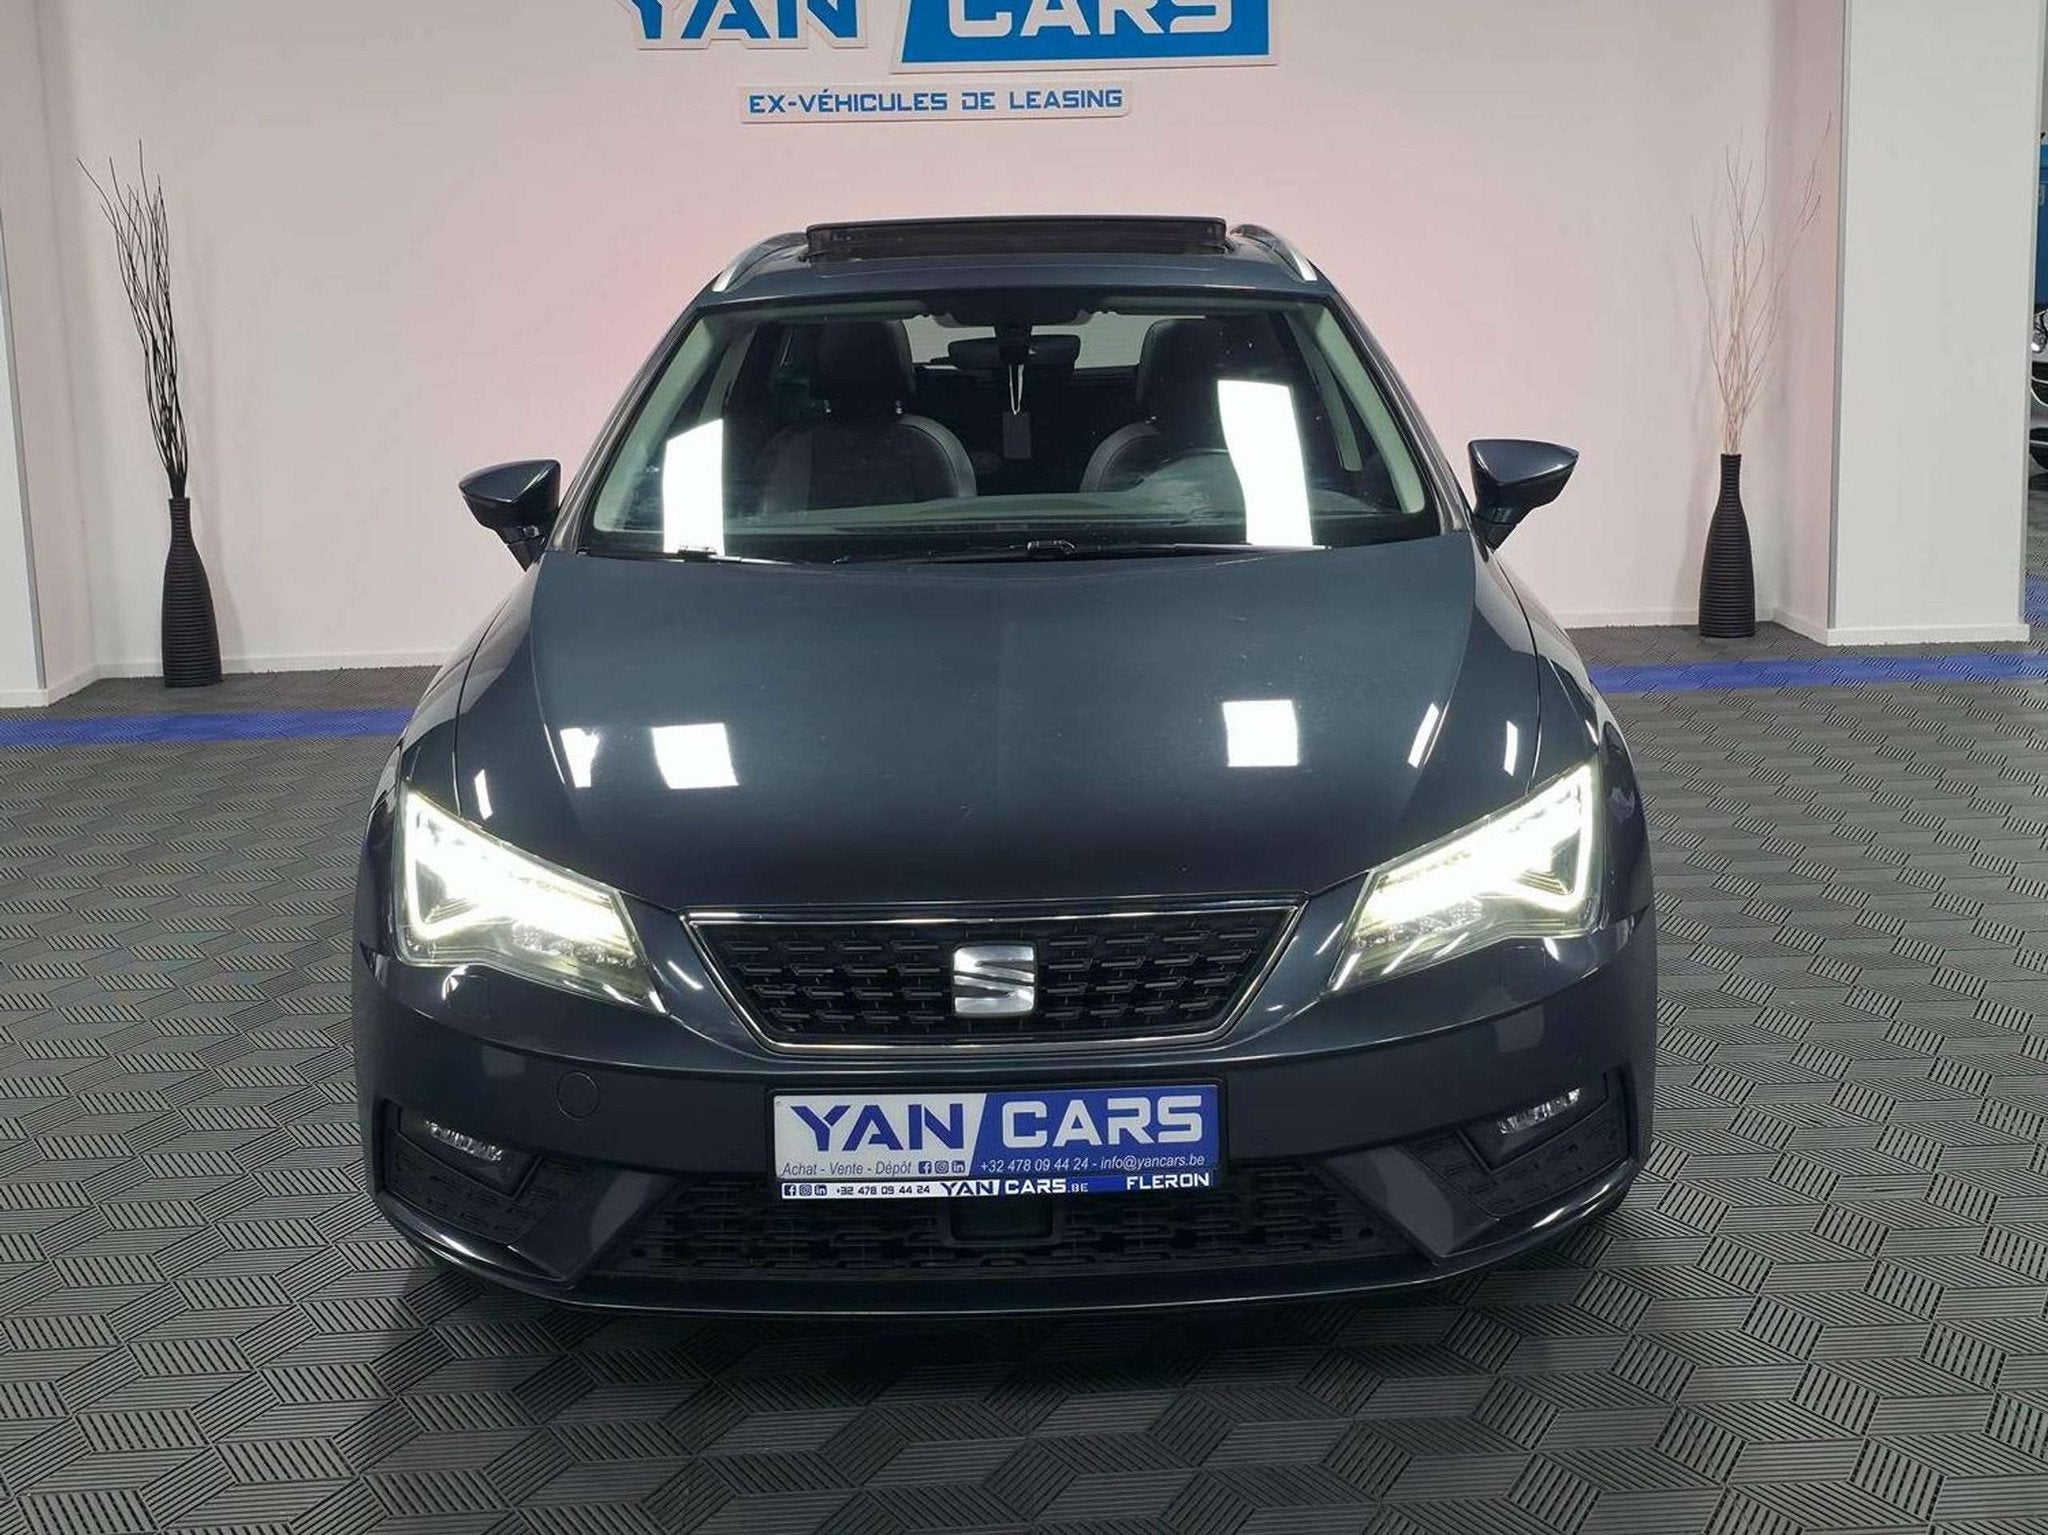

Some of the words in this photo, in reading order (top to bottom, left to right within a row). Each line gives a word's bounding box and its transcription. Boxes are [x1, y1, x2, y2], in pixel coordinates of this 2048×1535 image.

[749, 89, 948, 113] EX-VÉHICULES
[961, 91, 996, 111] DE
[1009, 89, 1123, 109] LEASING
[791, 1103, 964, 1152] YAN
[1002, 1095, 1203, 1149] CARS
[782, 1162, 818, 1176] Achat
[830, 1162, 864, 1176] Vente
[875, 1160, 912, 1178] Dépôt
[981, 1159, 1005, 1173] +32
[1007, 1159, 1031, 1172] 478
[1035, 1158, 1051, 1171] 09
[1053, 1158, 1070, 1171] 44
[1073, 1157, 1089, 1170] 24
[1100, 1154, 1205, 1171] info@yancars.be
[836, 1186, 854, 1196] +32
[857, 1185, 877, 1195] 478
[881, 1185, 895, 1195] 09
[899, 1185, 913, 1194] 44
[916, 1184, 931, 1194] 24
[940, 1180, 995, 1196] YAN
[1126, 1172, 1210, 1190] FLERON
